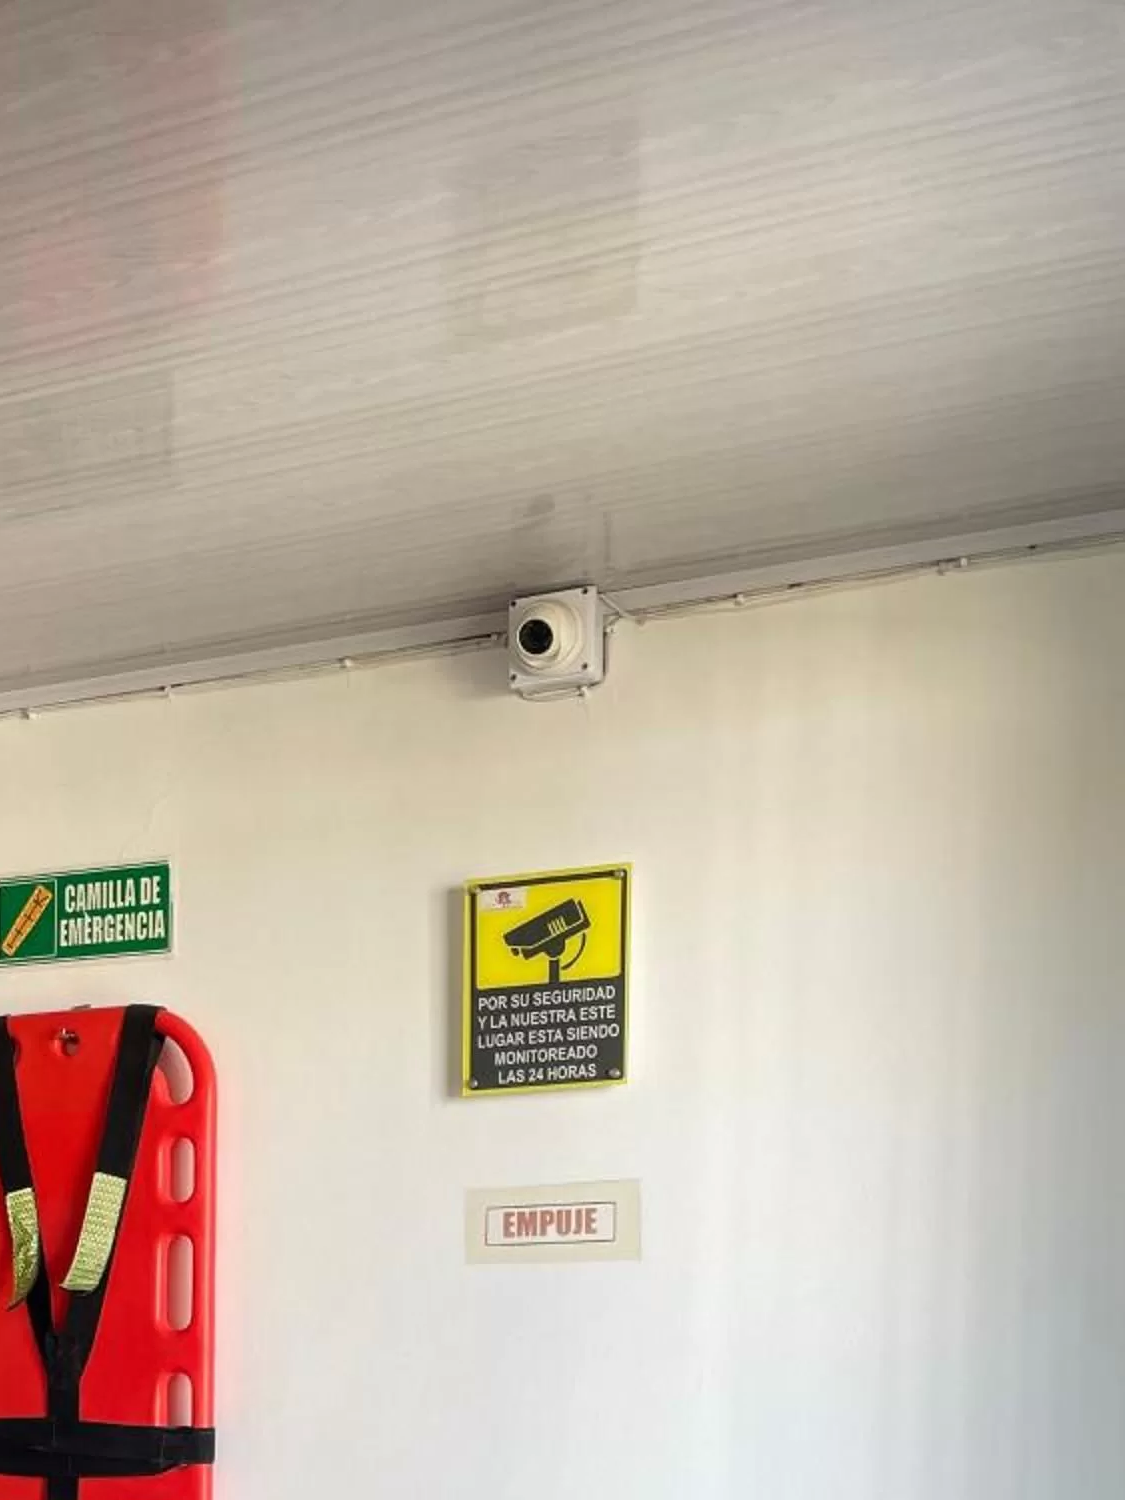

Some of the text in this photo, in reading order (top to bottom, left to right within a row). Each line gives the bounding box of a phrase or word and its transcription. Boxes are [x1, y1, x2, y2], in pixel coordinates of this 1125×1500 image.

[64, 875, 162, 913] CAMILLA DE
[59, 910, 166, 947] EMERGENCIA
[478, 986, 616, 1011] POR SU SEGURIDAD
[478, 1005, 616, 1030] Y LA NUESTRA ESTE
[478, 1023, 620, 1049] LUGAR ESTA SIENDO
[494, 1045, 598, 1065] MONITOREADO
[498, 1064, 597, 1084] LAS 24 HORAS
[504, 1208, 598, 1239] EMPUJE
